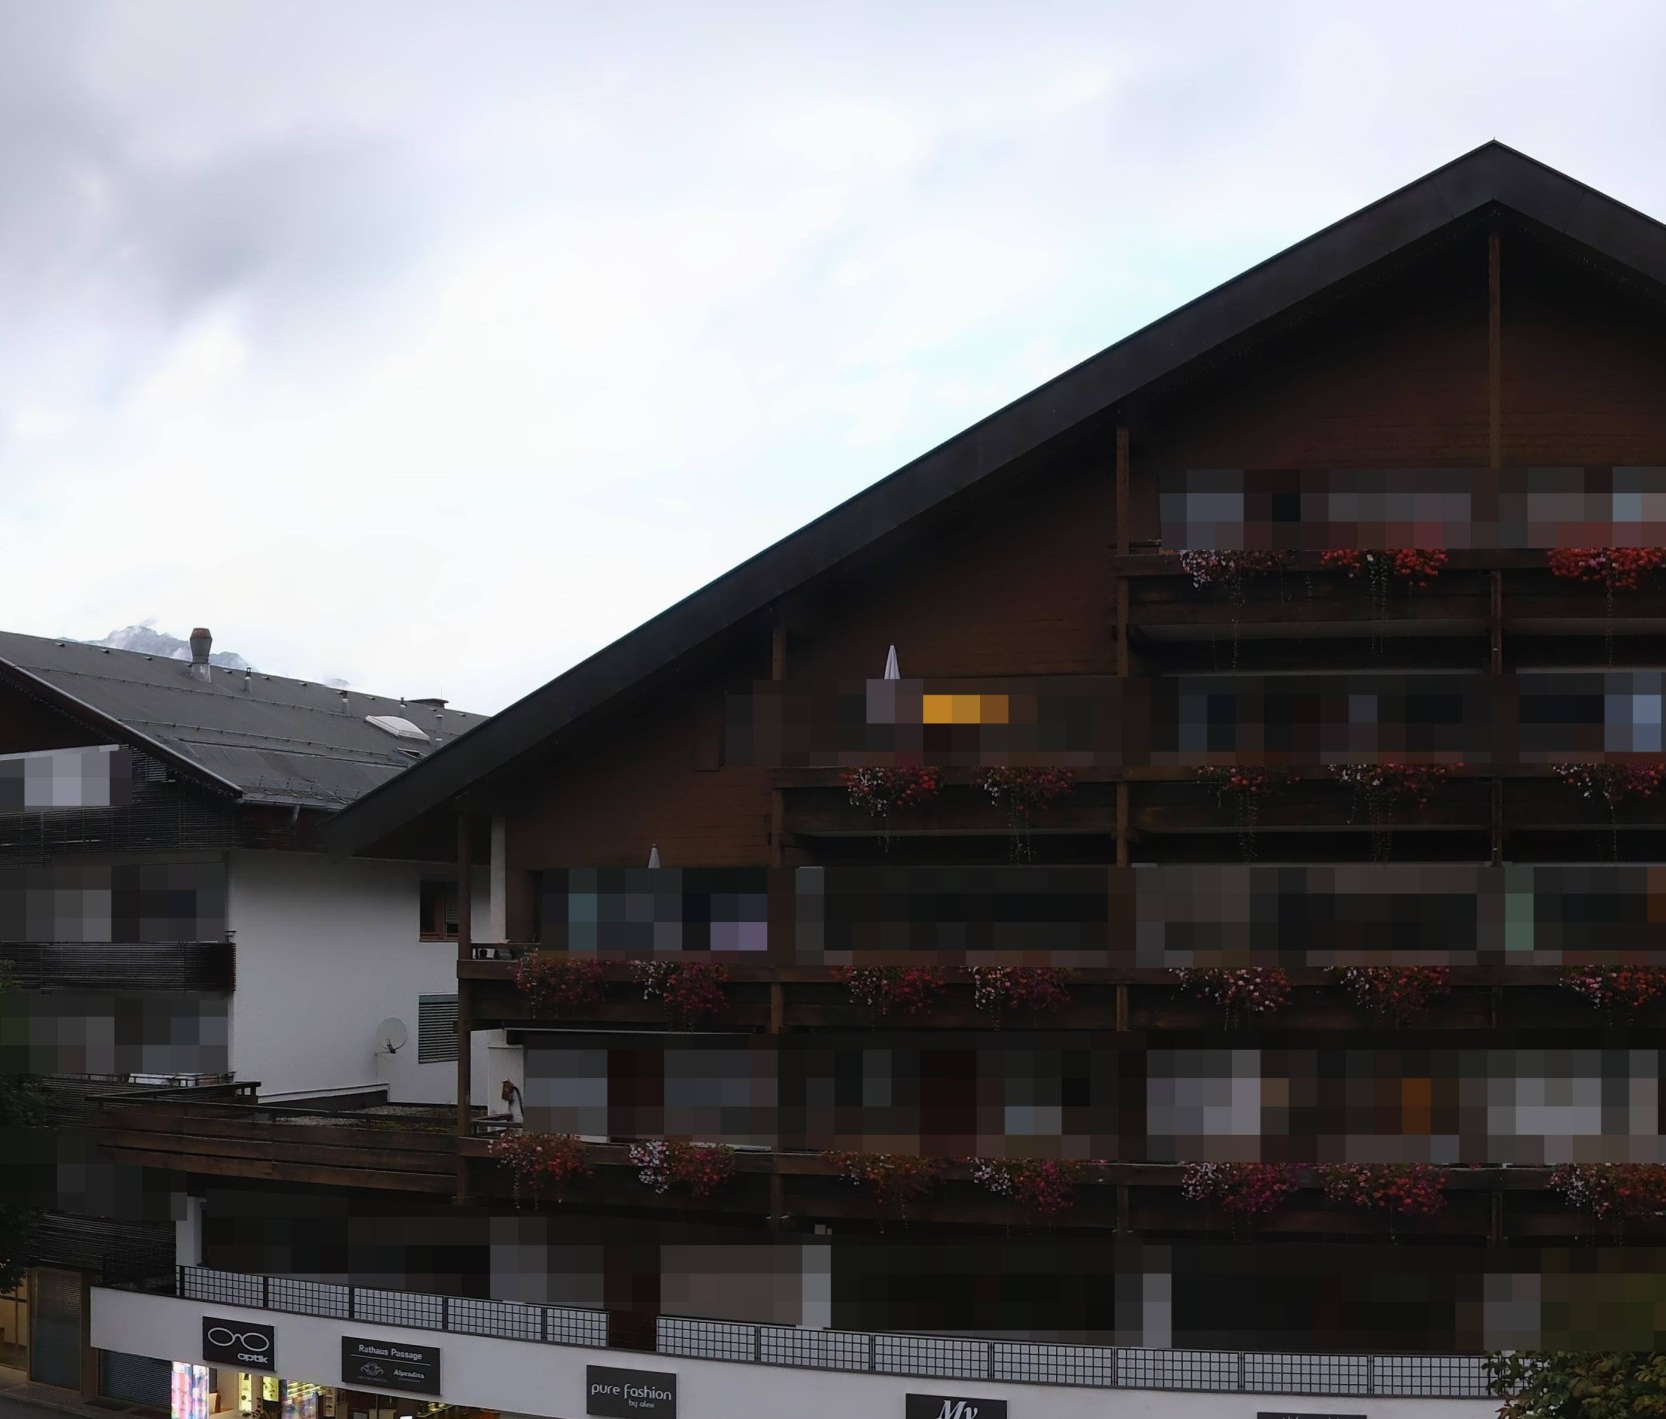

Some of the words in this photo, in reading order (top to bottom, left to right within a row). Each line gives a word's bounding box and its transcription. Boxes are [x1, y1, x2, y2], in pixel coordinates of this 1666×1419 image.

[237, 1352, 269, 1364] optik
[359, 1344, 388, 1356] Rathaus
[391, 1348, 422, 1360] Passage
[591, 1383, 620, 1396] pure
[624, 1383, 672, 1400] fashion
[629, 1399, 638, 1408] by
